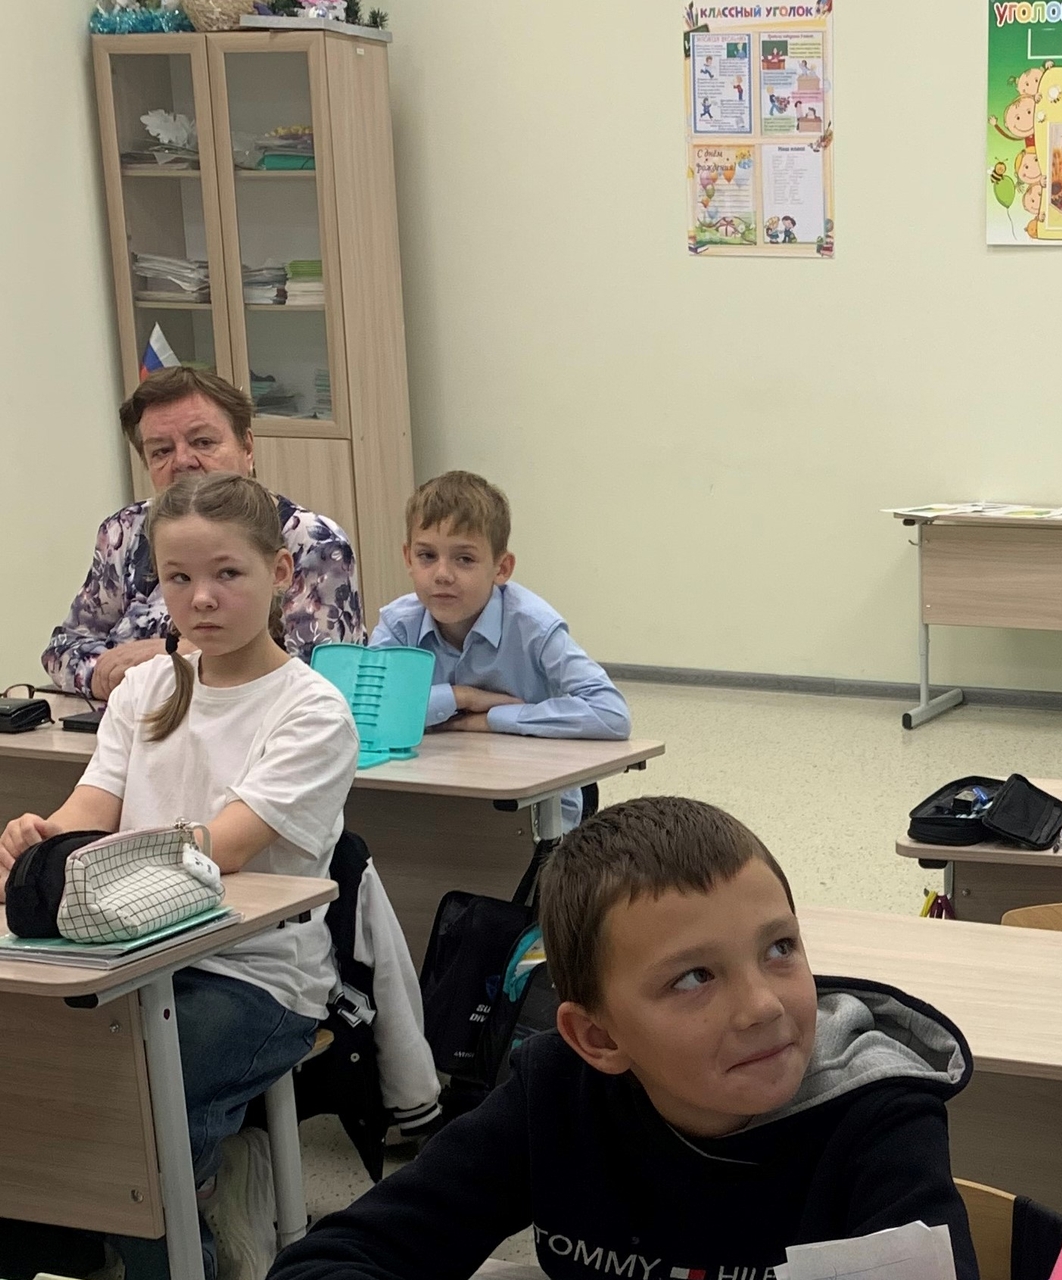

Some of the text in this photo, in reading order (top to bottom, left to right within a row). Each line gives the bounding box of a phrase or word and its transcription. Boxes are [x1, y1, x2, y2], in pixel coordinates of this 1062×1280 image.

[700, 5, 813, 18] КЛАССНЫЙ УГОЛОК
[533, 1223, 661, 1280] TOMMY
